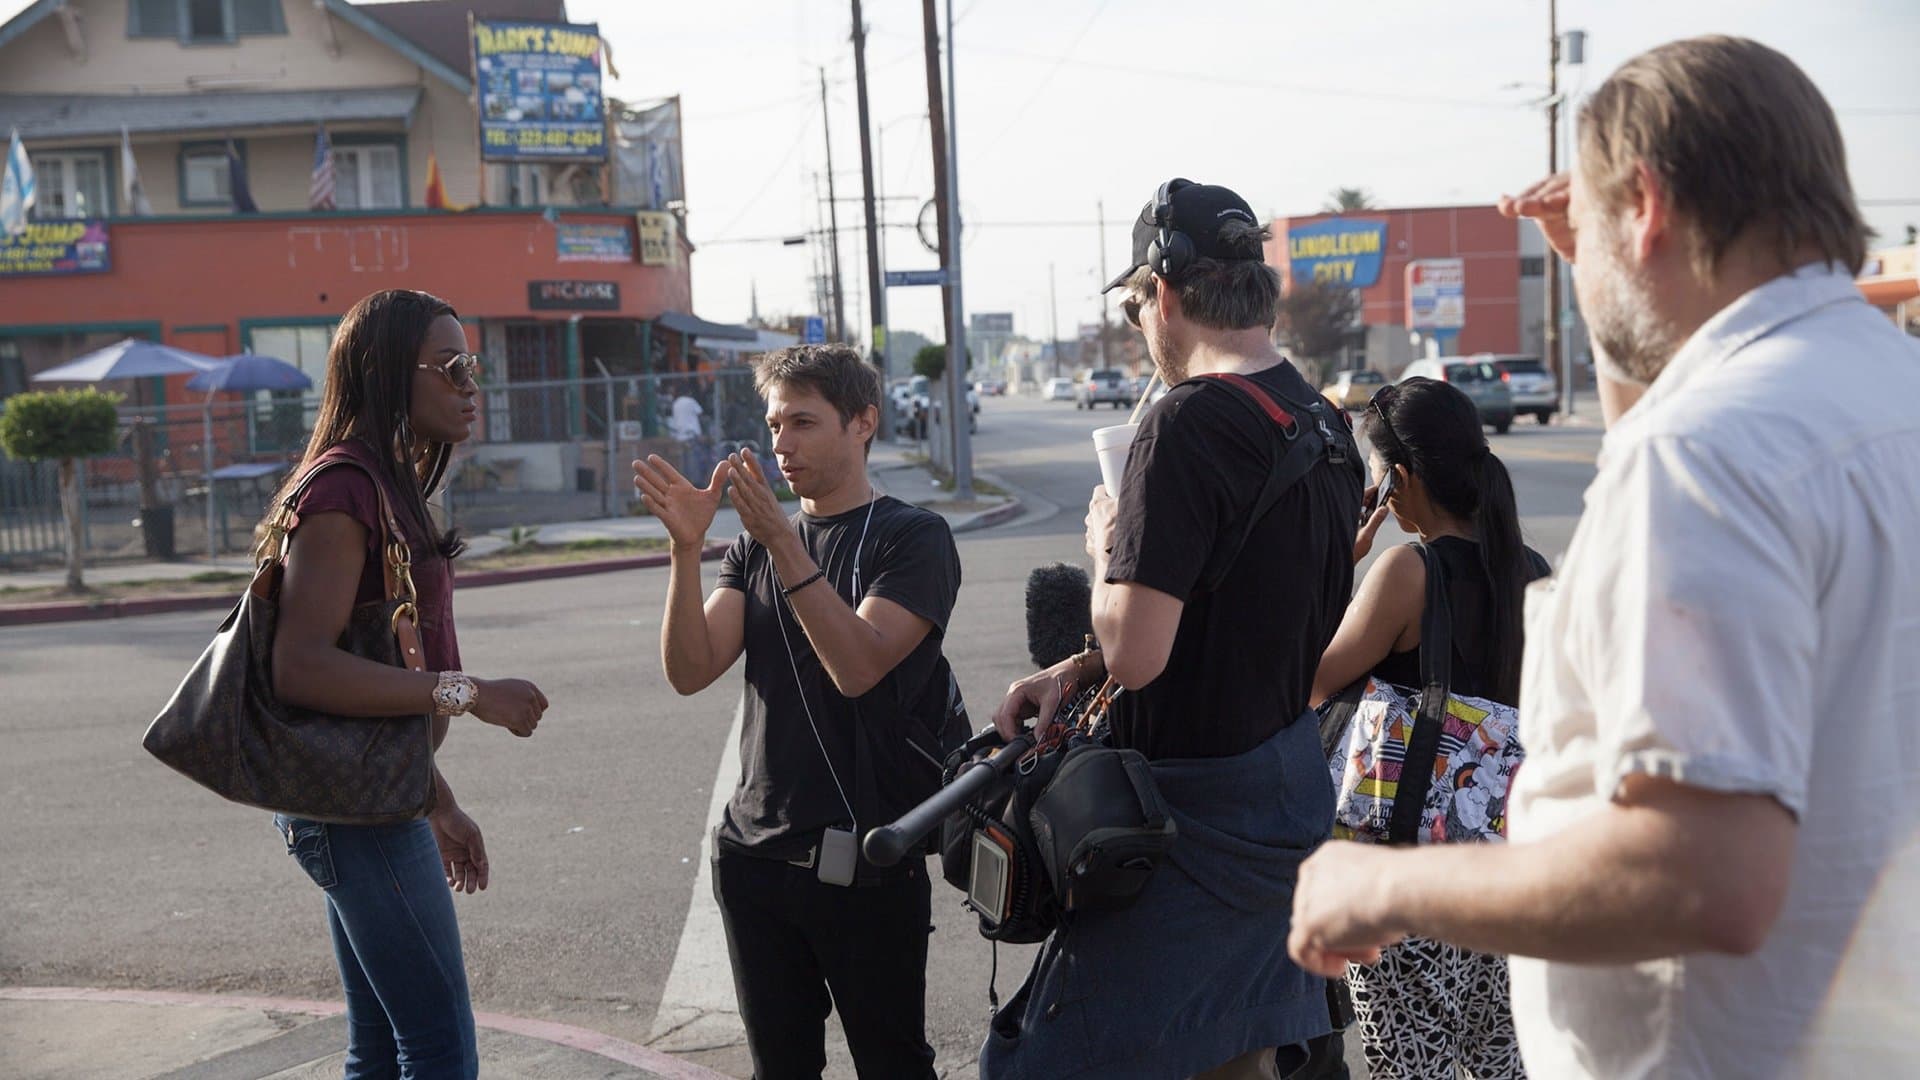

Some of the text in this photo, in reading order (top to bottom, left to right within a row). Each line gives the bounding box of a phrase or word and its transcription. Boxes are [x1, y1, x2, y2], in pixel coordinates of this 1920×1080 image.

[476, 23, 599, 58] MARK'S JUMP
[19, 223, 85, 245] JUMP
[1290, 229, 1380, 259] LINOLEUM
[1313, 260, 1355, 284] CITY
